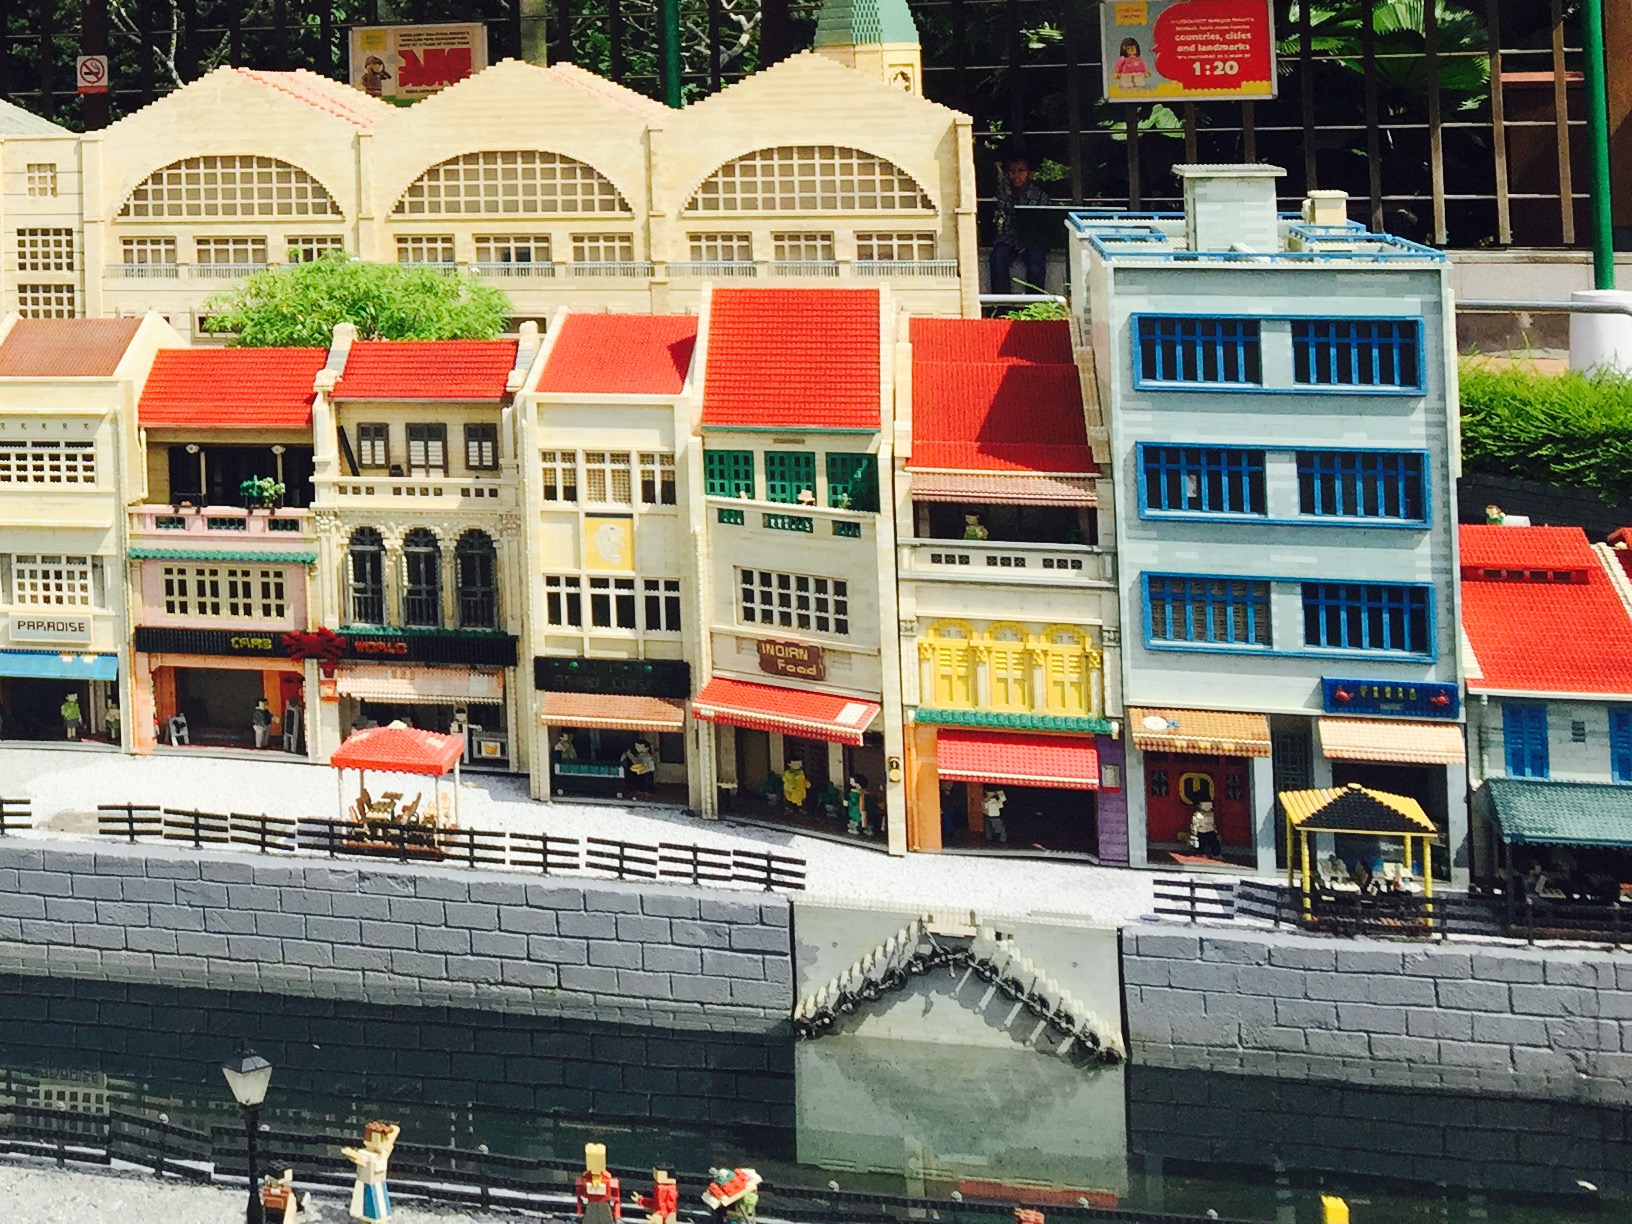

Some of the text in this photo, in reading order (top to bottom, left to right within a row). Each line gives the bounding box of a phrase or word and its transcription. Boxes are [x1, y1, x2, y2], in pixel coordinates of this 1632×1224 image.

[1175, 31, 1251, 42] countries, cities
[1177, 43, 1250, 52] and landmarks
[1193, 61, 1239, 75] 1:20
[17, 620, 85, 632] PARADISE
[761, 643, 808, 661] INDIAN
[777, 658, 817, 676] Food
